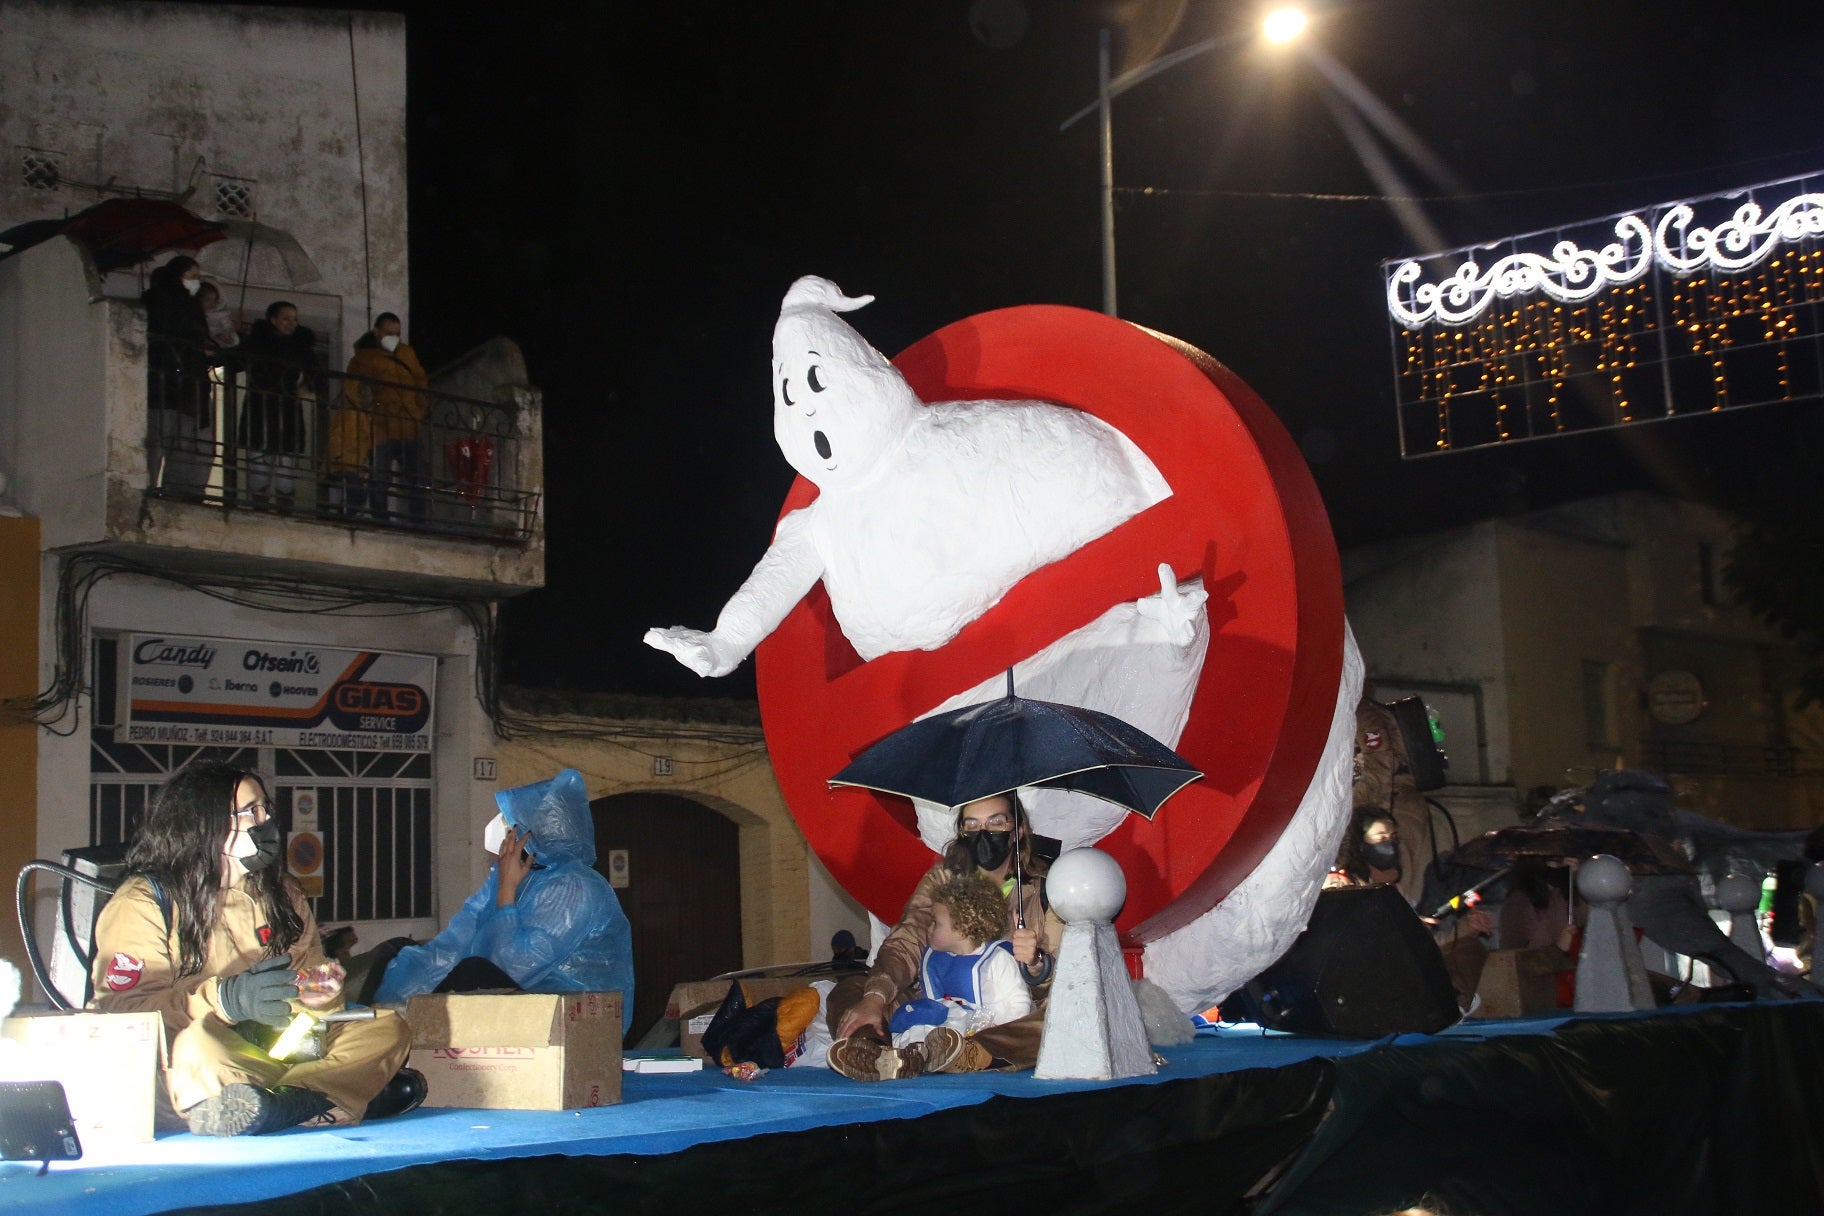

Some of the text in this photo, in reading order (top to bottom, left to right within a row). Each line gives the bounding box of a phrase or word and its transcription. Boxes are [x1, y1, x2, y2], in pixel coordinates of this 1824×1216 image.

[133, 639, 216, 670] Candy
[243, 649, 304, 673] Otsein
[132, 676, 176, 688] ROSIERES
[224, 678, 258, 693] Iberna
[283, 685, 318, 697] HOOVER
[341, 686, 417, 711] GIAS
[360, 716, 396, 731] SERVICE
[129, 725, 156, 740] PEDRO
[479, 761, 495, 777] 17
[658, 757, 671, 773] 19
